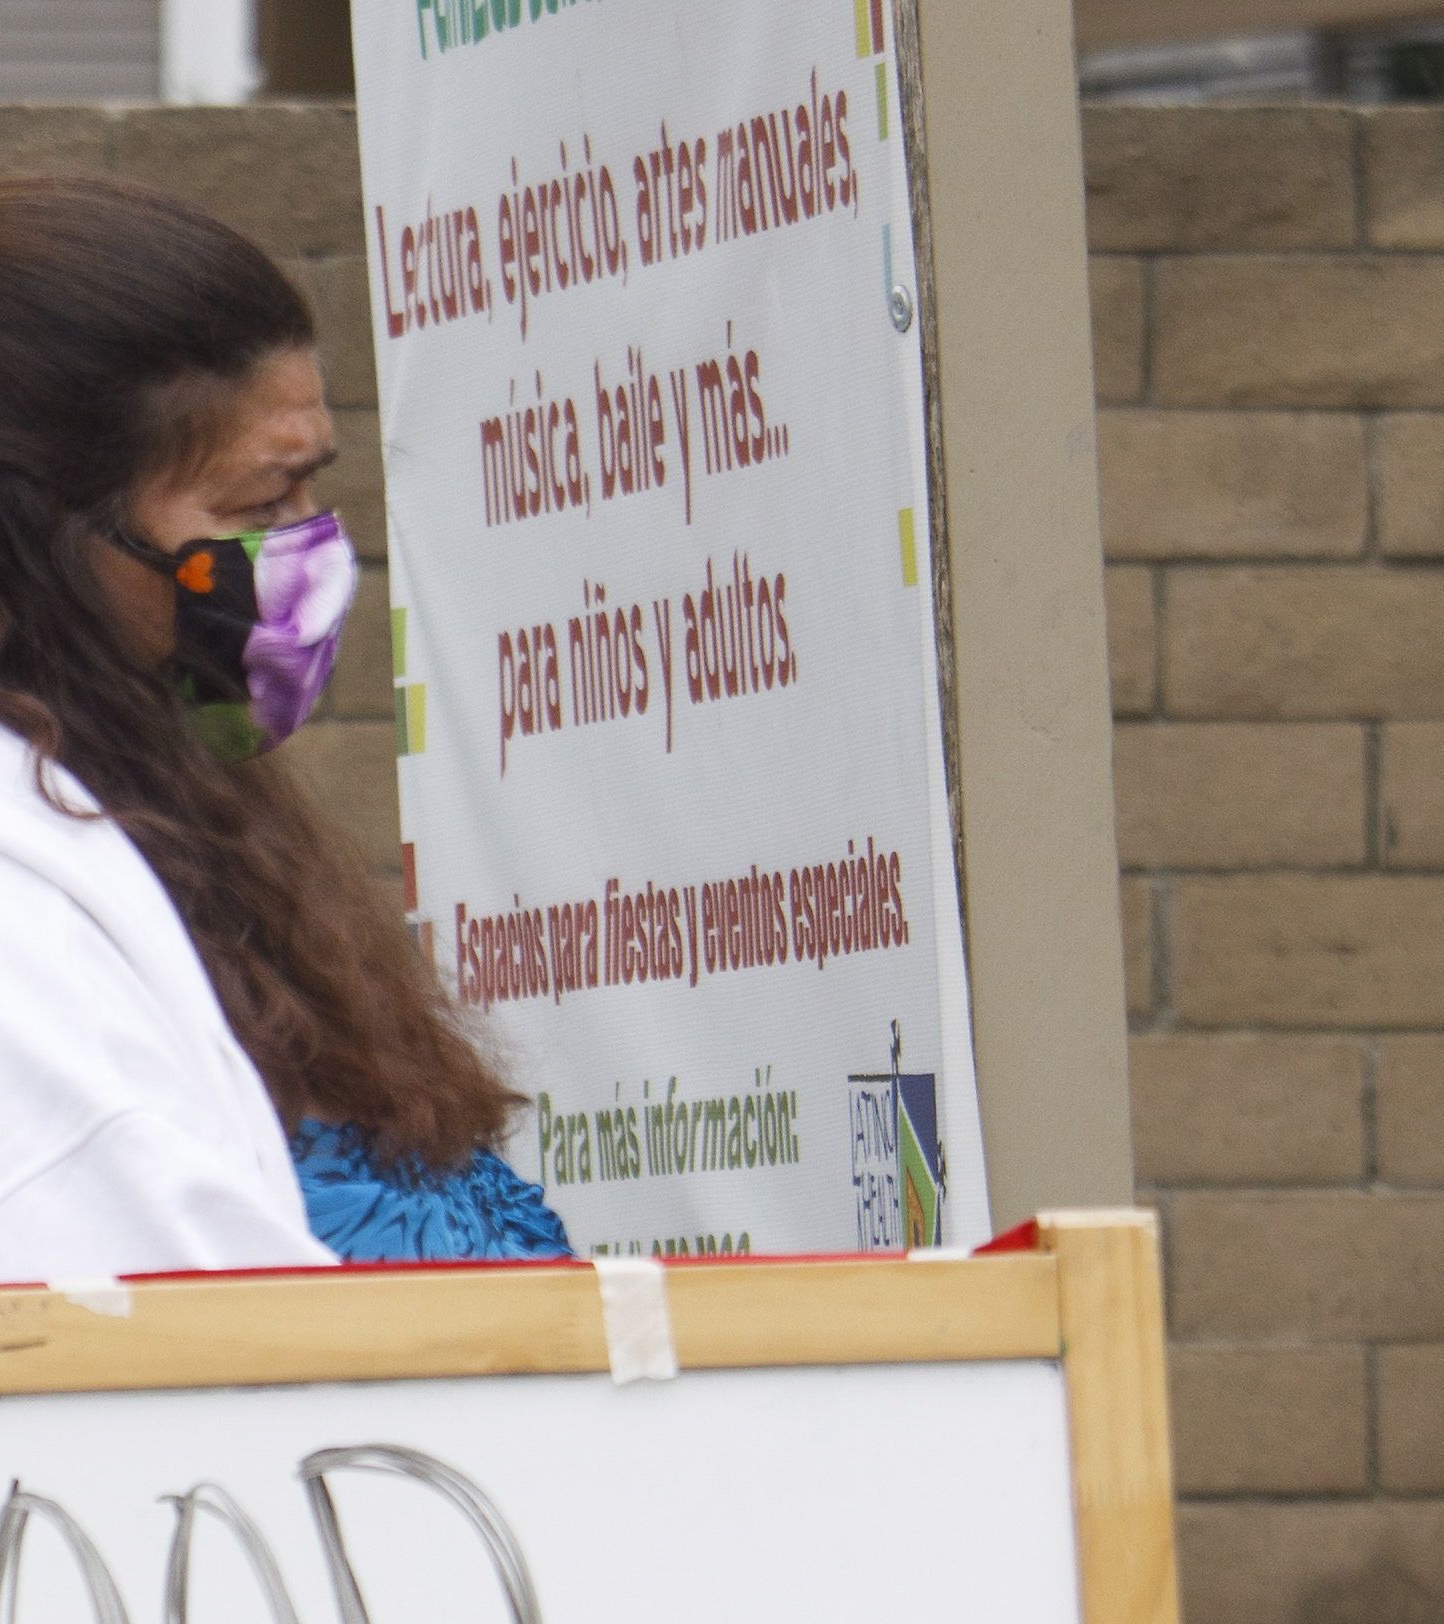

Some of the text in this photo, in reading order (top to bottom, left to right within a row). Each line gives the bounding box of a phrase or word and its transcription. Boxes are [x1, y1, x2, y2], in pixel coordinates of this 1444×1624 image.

[376, 65, 858, 343] Lectura, ejercicio, artes manuales,
[480, 320, 789, 527] música, baile y más...
[498, 549, 796, 781] para niños y adultos.
[455, 836, 909, 1013] Espacios para fiestas y eventos especiales.
[538, 1064, 799, 1187] Para más información:
